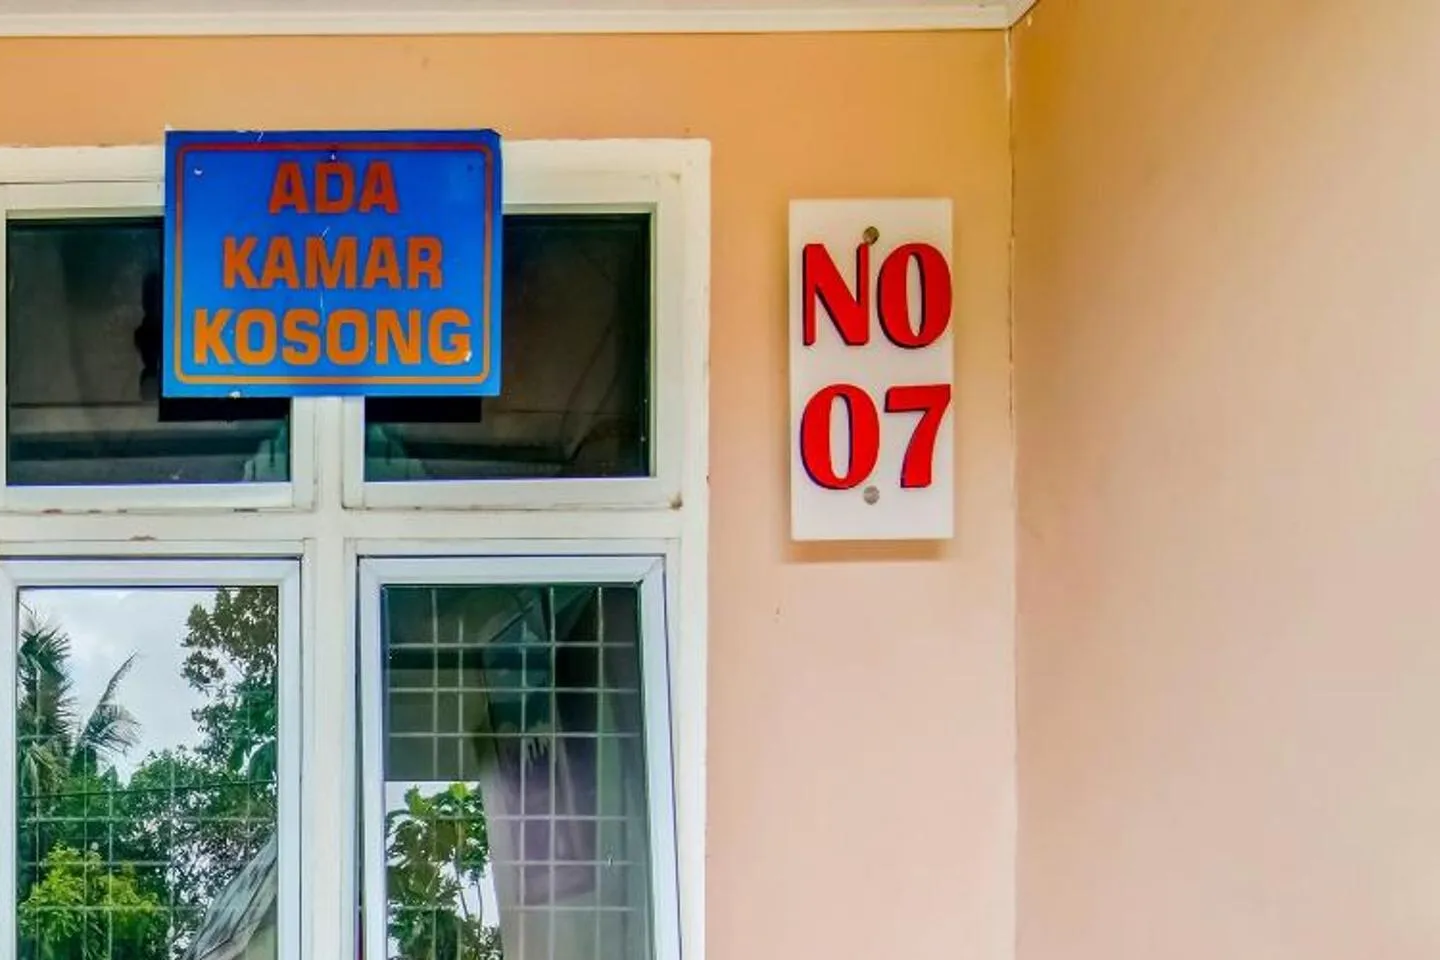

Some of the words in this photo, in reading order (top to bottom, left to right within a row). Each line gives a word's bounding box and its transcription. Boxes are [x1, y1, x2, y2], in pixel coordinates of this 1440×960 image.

[268, 161, 400, 214] ADA
[222, 236, 444, 289] KAMAR
[801, 242, 952, 349] NO
[193, 308, 473, 366] KOSONG
[800, 383, 952, 490] 07
